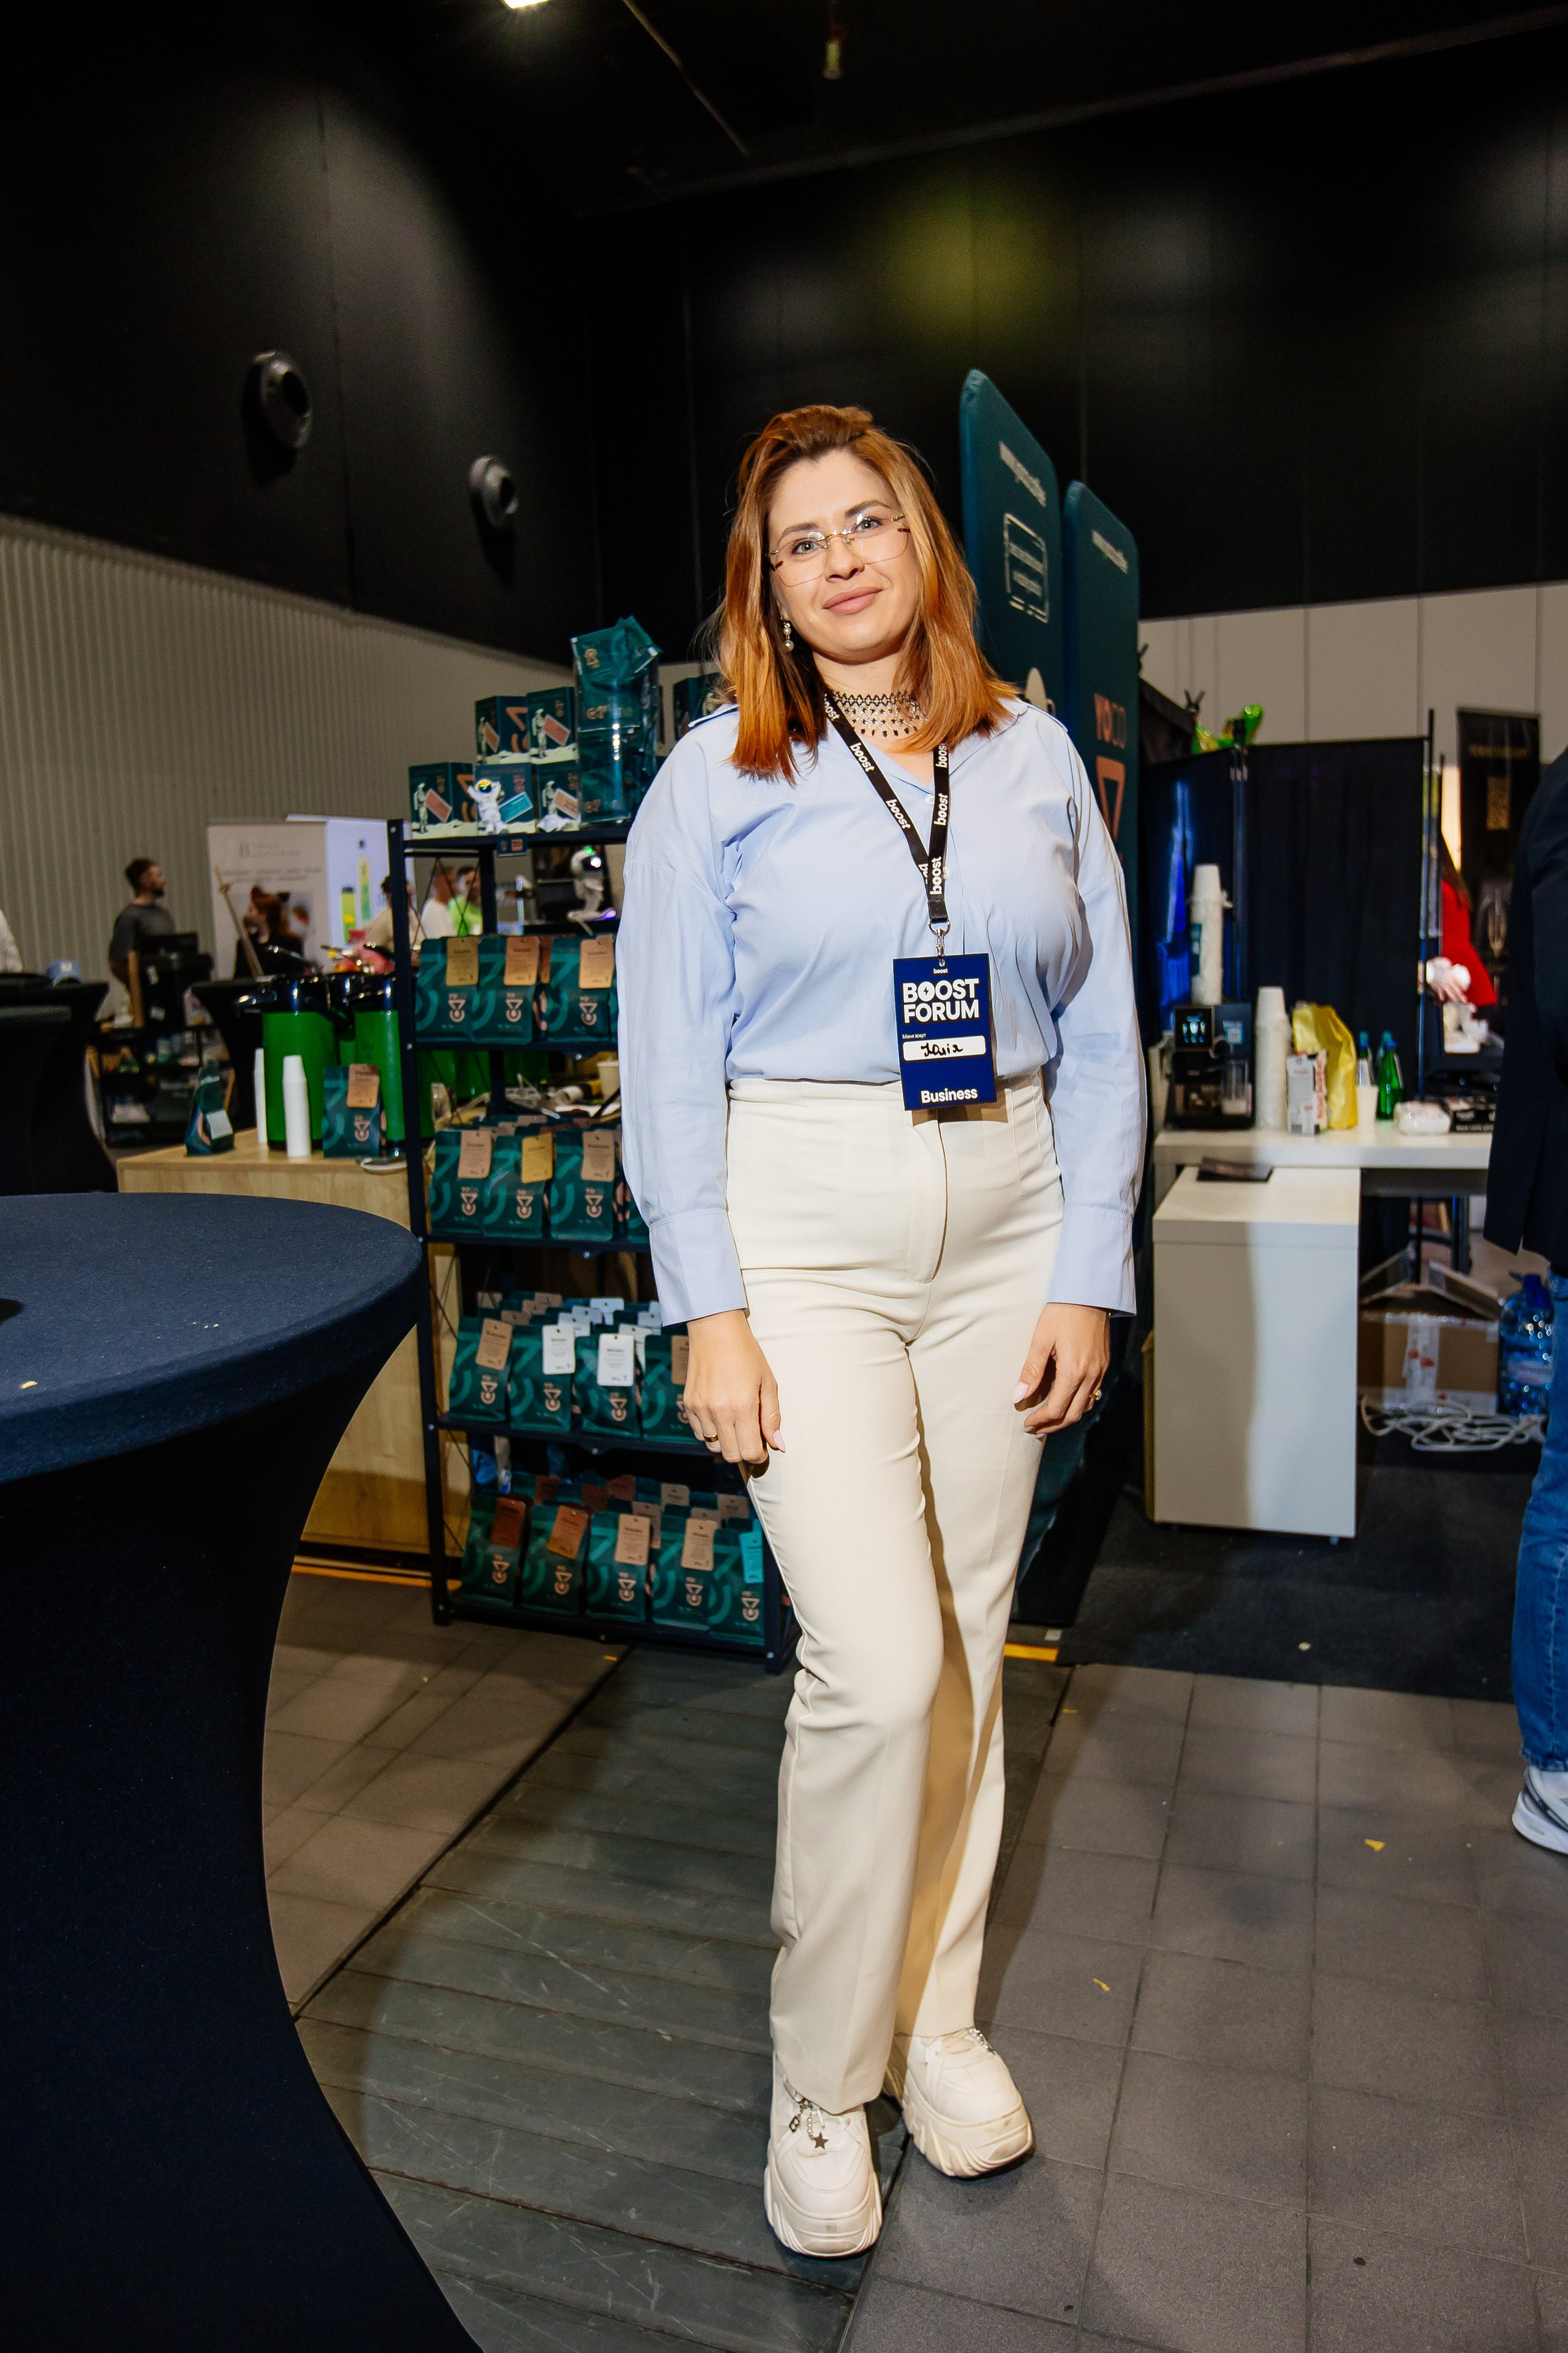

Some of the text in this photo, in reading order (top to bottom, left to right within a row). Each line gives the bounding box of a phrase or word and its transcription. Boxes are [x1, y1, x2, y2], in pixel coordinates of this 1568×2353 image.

[824, 693, 840, 721] oost
[850, 742, 875, 772] boost
[886, 799, 911, 829] boost
[934, 793, 948, 826] boost
[930, 856, 943, 894] boost
[903, 978, 979, 1003] BOOST
[903, 999, 979, 1023] FORUM
[921, 1088, 978, 1103] Business
